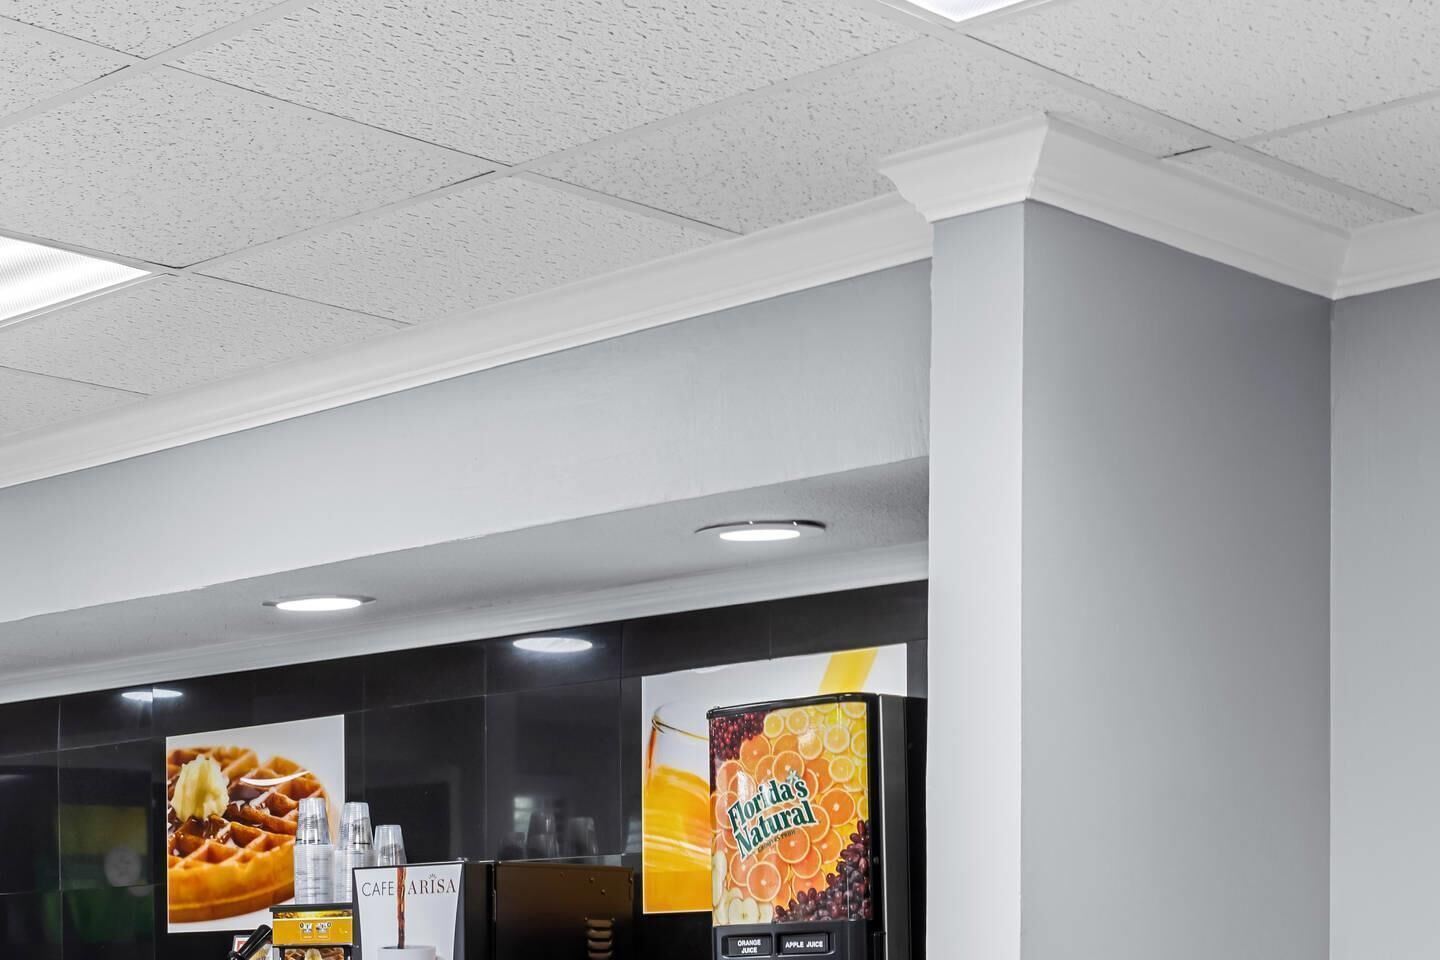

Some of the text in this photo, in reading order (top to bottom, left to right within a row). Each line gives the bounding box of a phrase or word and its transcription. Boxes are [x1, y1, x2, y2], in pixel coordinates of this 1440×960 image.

[735, 799, 817, 860] Natural
[361, 880, 395, 897] CAFE
[737, 939, 762, 947] ORANGE
[785, 940, 824, 949] APPLE JUICE
[740, 946, 758, 954] JUICE
